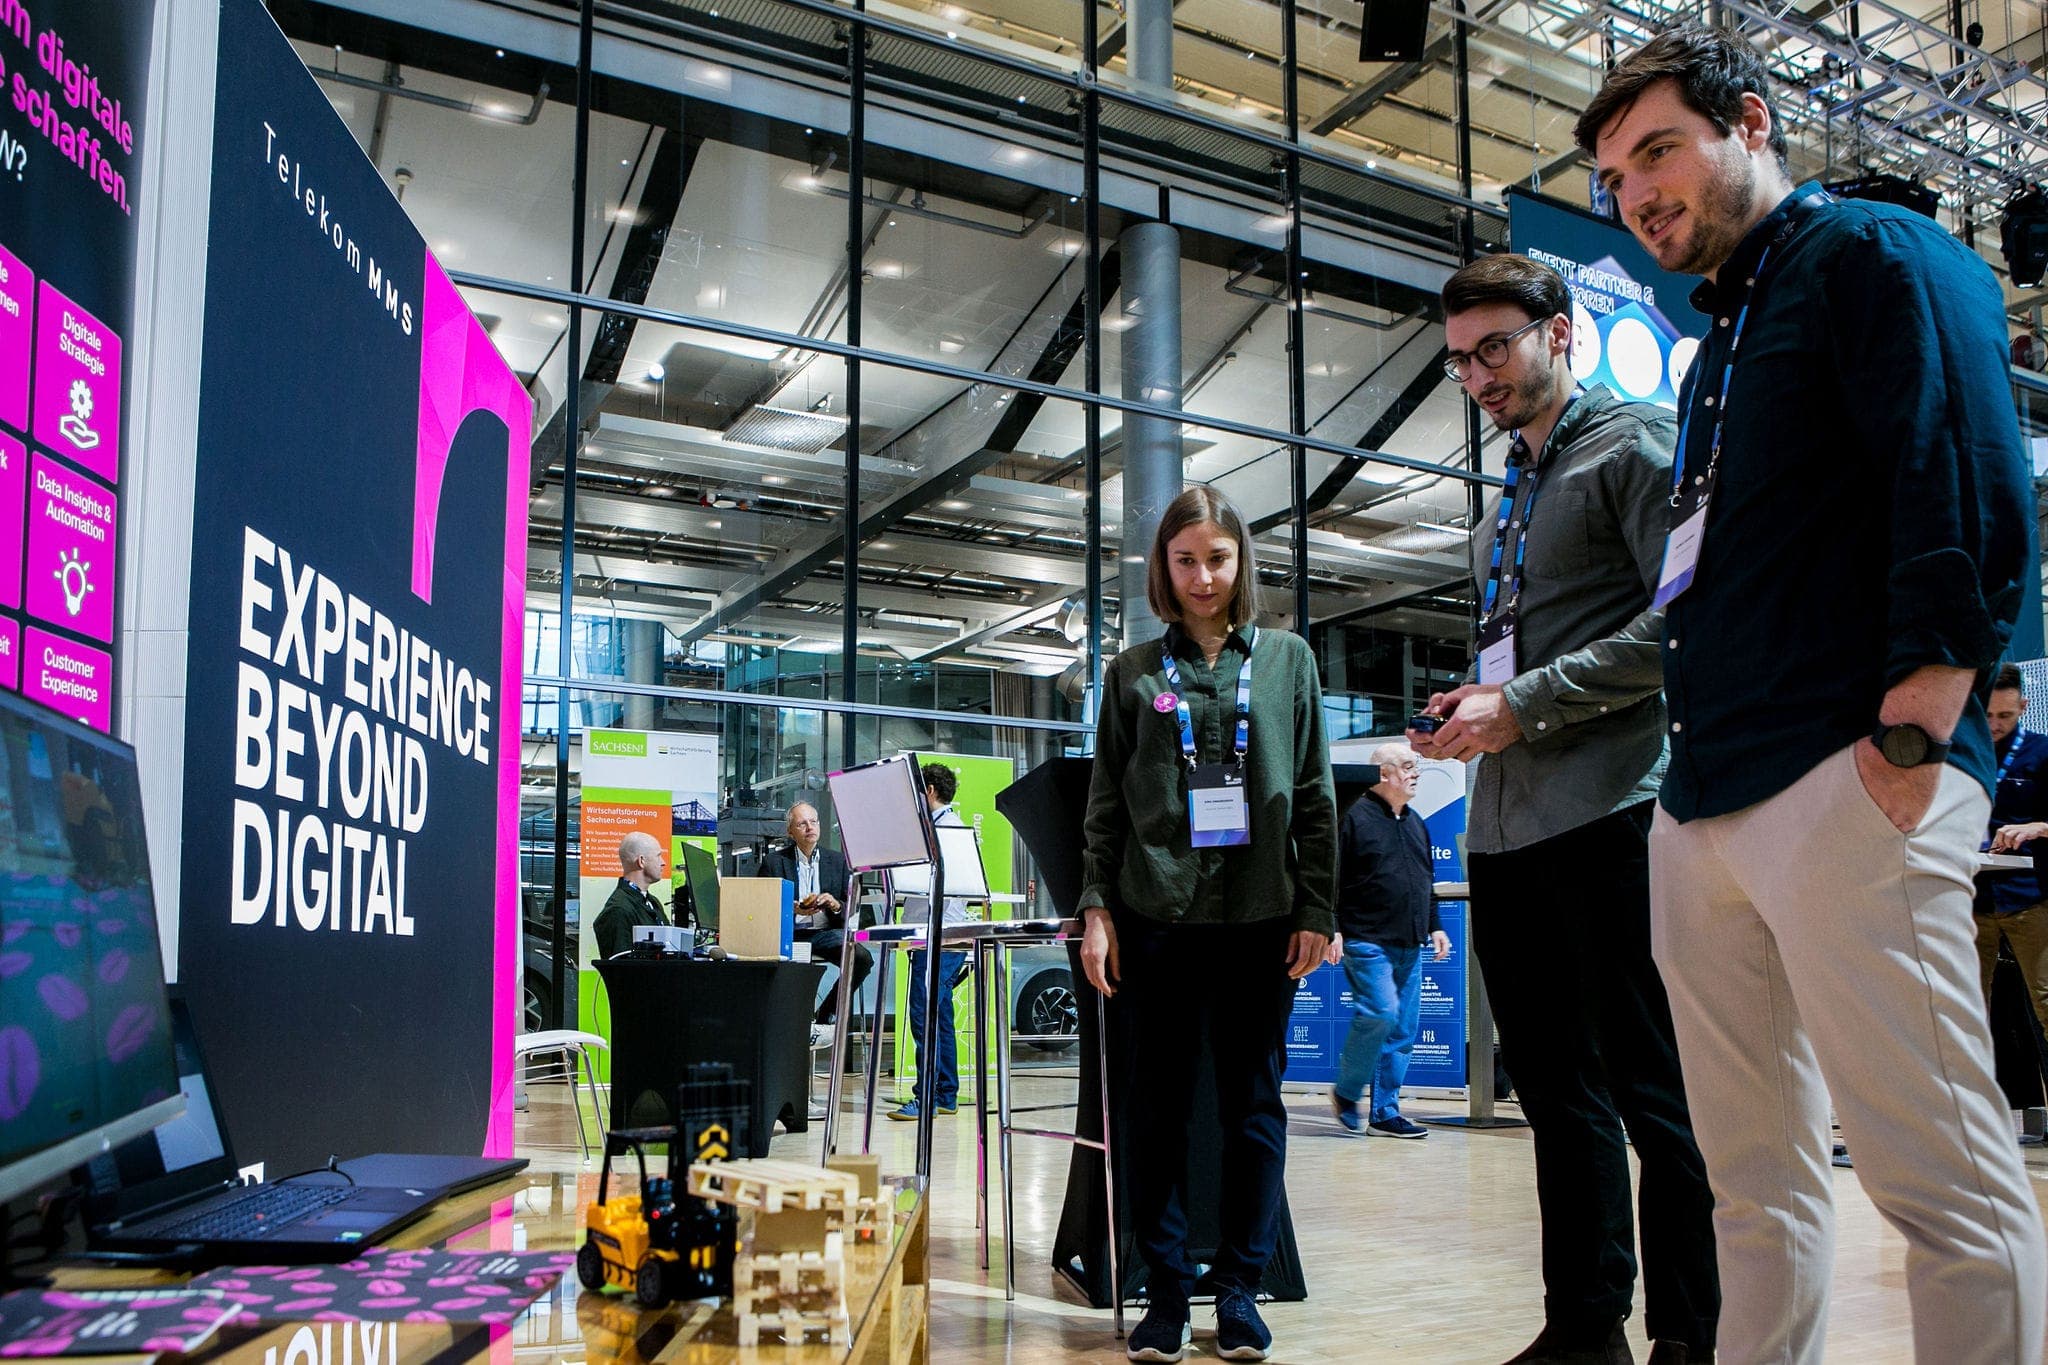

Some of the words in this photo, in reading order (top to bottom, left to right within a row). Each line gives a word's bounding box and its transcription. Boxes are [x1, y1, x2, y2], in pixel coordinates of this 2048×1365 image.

[37, 29, 133, 156] digitale
[12, 72, 132, 216] schaffen.
[263, 121, 361, 274] Telekom
[369, 257, 413, 336] MMS
[1577, 263, 1643, 302] PARTNER
[63, 311, 102, 351] Digitale
[60, 333, 105, 376] Strategie
[37, 470, 63, 499] Data
[64, 484, 103, 518] Insights
[104, 505, 112, 524] &
[46, 499, 105, 542] Automation
[44, 647, 95, 678] Customer
[239, 525, 492, 765] EXPERIENCE
[41, 669, 98, 702] Experience
[235, 661, 428, 834] BEYOND
[593, 740, 644, 754] SACHSEN!
[586, 807, 658, 818] Wirtschaftsförderung
[586, 815, 615, 824] Sachsen
[616, 817, 637, 825] GmbH
[231, 798, 414, 936] DIGITAL
